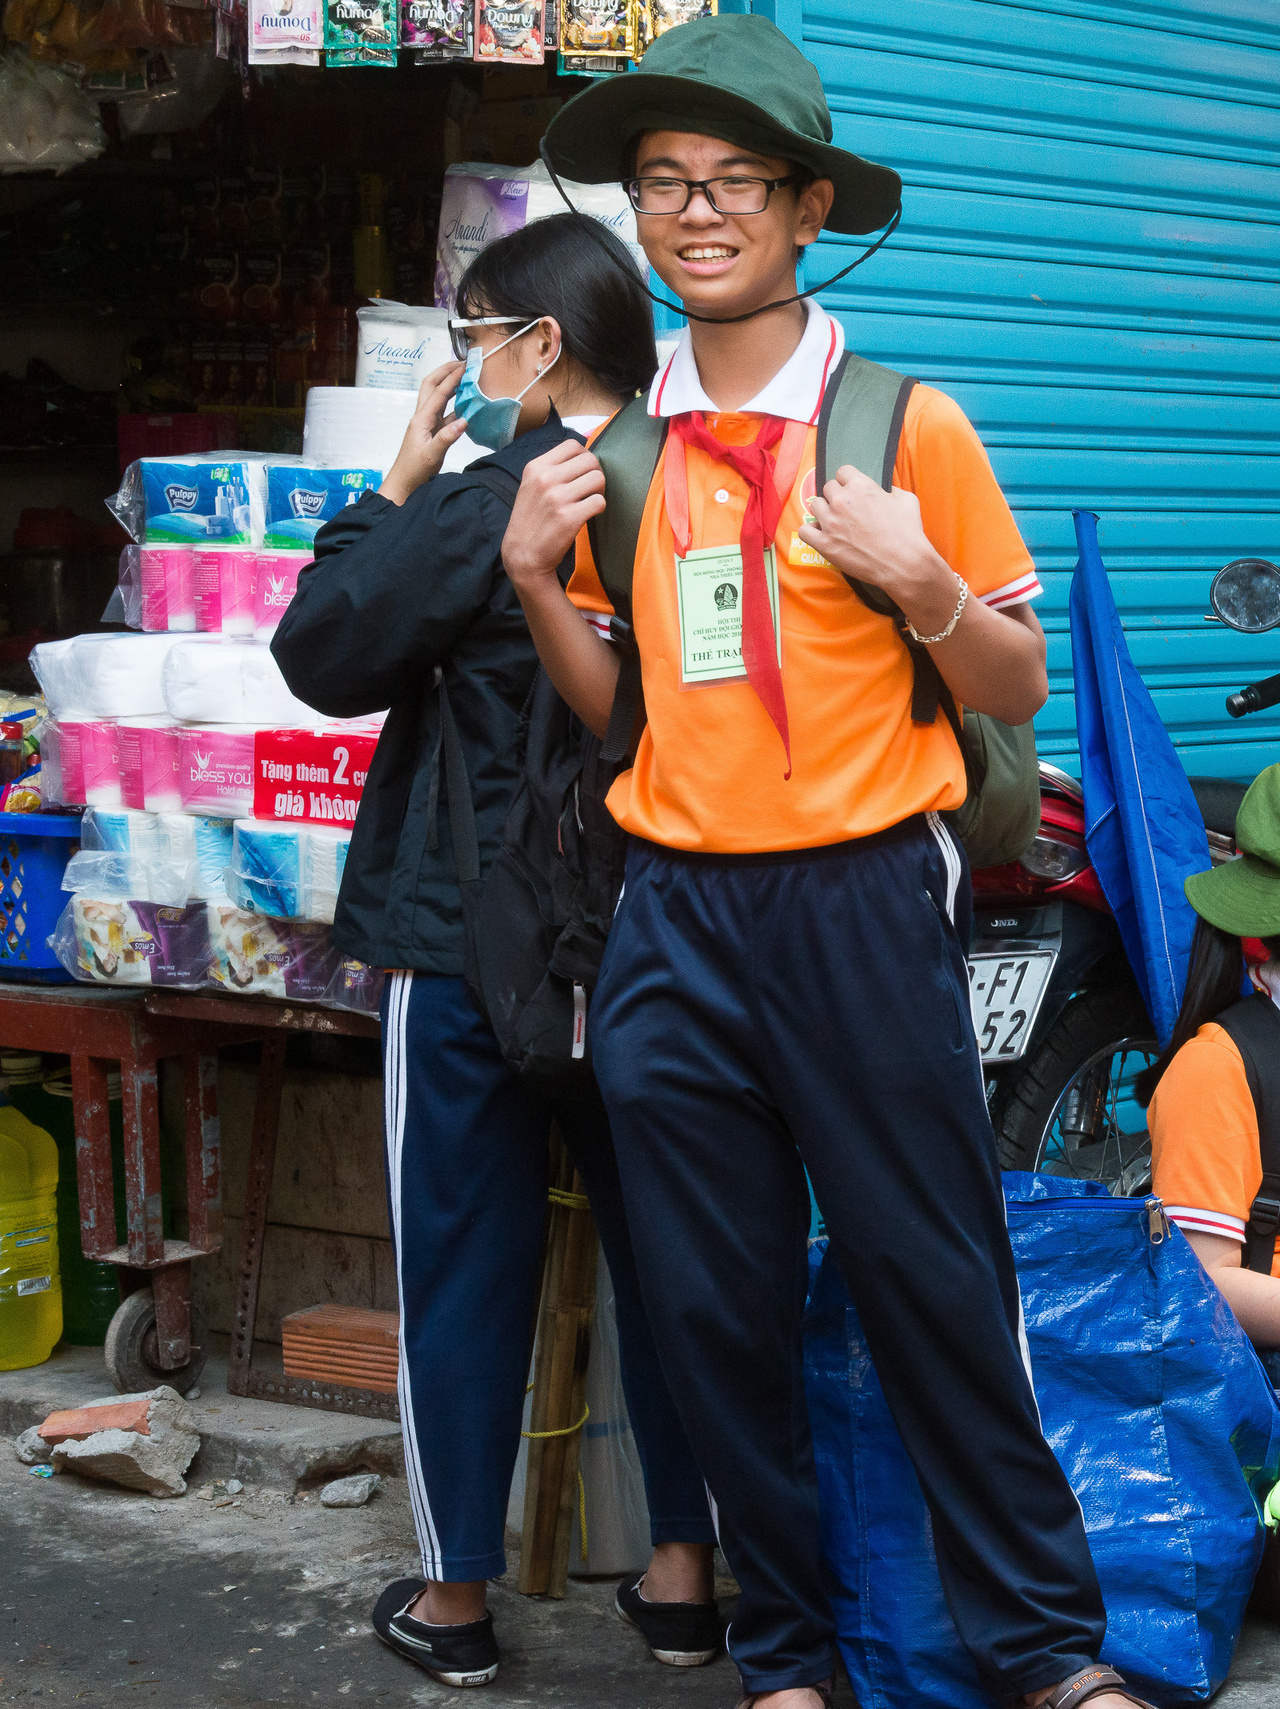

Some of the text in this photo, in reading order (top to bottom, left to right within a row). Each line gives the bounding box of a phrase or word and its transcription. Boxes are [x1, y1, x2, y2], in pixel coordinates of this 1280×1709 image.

[336, 4, 382, 20] Downy
[409, 5, 455, 22] Downy
[487, 9, 534, 29] Downy
[261, 14, 312, 31] Downy
[364, 337, 426, 360] Anandi
[169, 488, 197, 503] Pulppy
[295, 494, 324, 508] Pulppy
[801, 552, 825, 567] QUẬN
[691, 648, 713, 662] THẺ
[261, 758, 292, 784] Tặng
[296, 759, 329, 784] thêm
[332, 747, 350, 785] 2
[191, 767, 252, 785] bless YOU
[216, 784, 252, 797] Hold me
[275, 789, 304, 818] giá
[135, 942, 156, 955] E'mos
[981, 1009, 1027, 1054] 52
